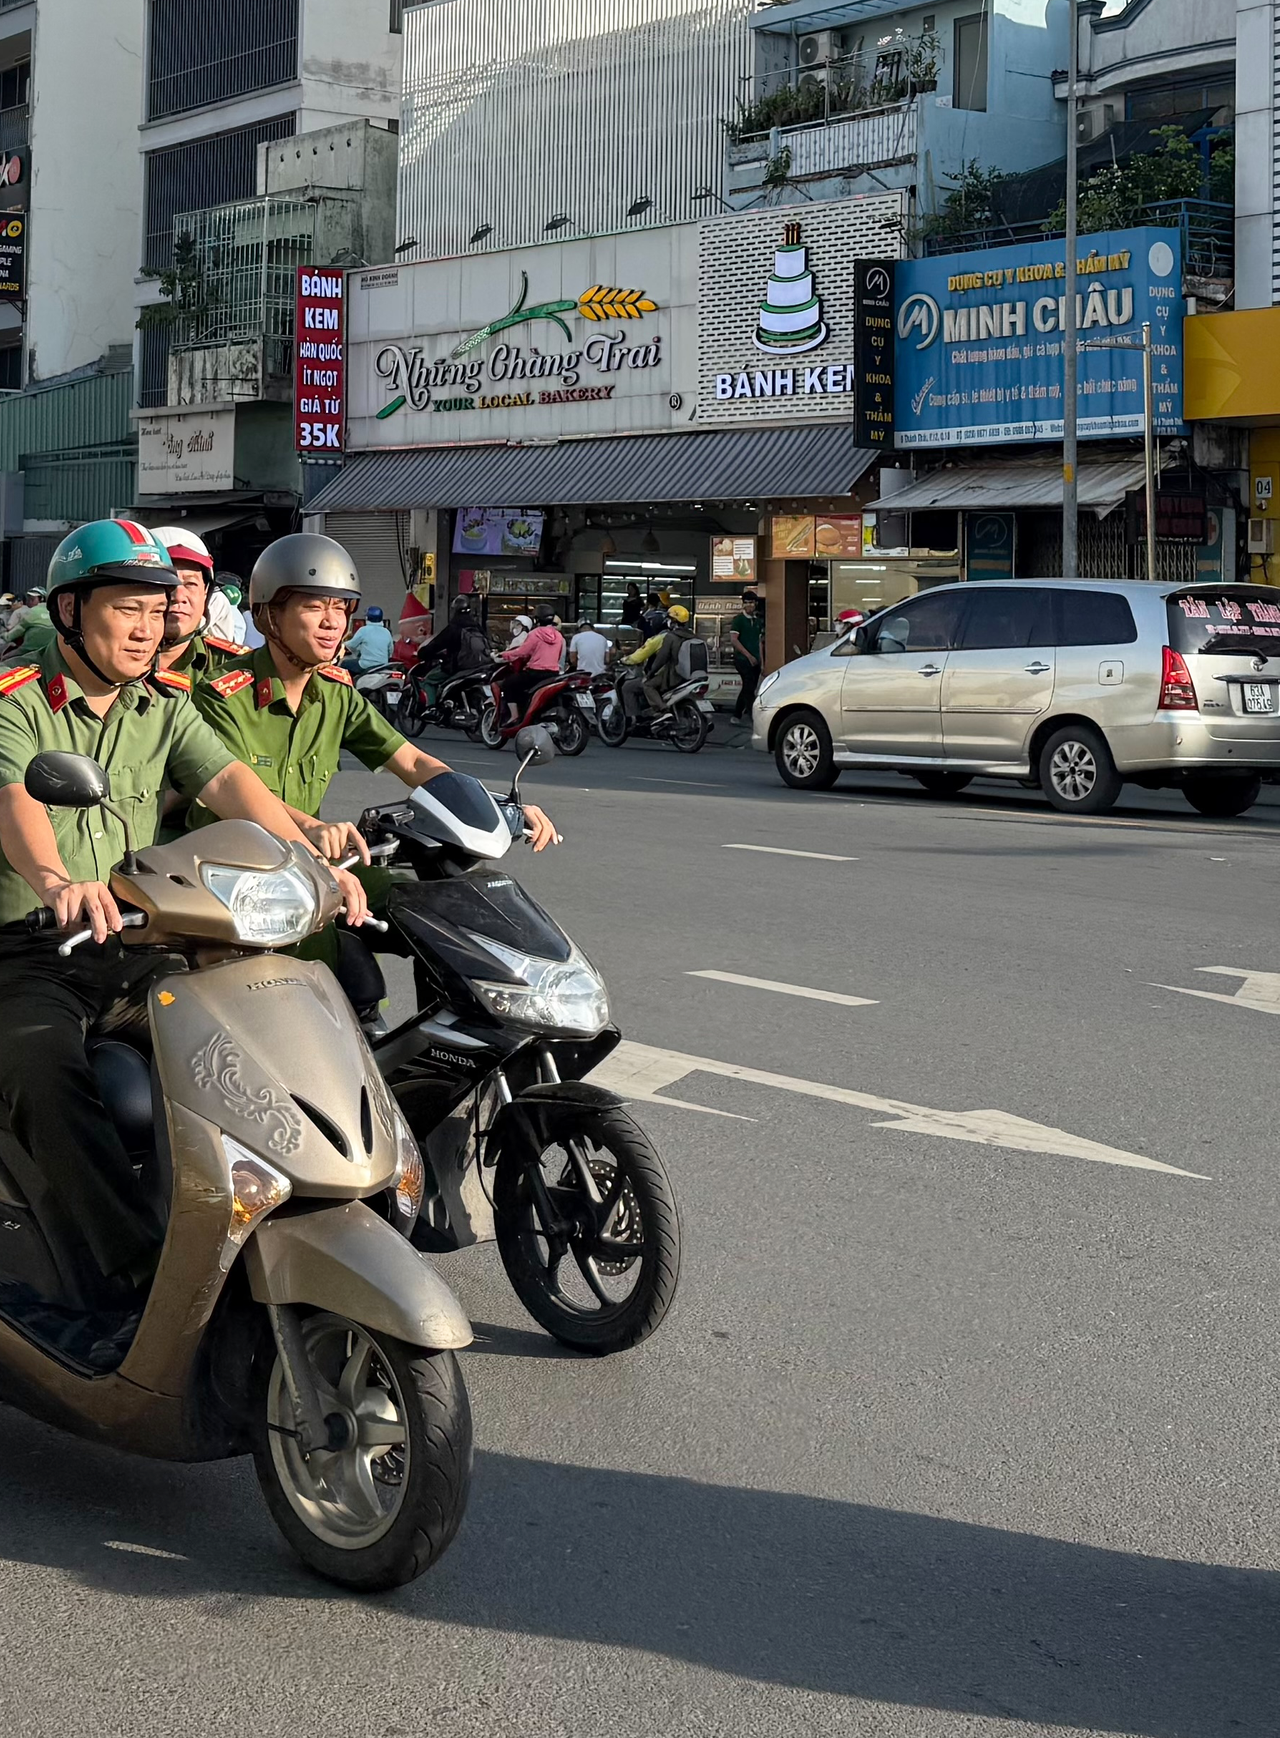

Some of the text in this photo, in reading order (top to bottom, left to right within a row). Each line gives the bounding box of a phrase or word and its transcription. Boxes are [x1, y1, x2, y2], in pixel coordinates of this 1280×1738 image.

[948, 272, 983, 295] DỤNG
[984, 269, 1004, 290] CỤ
[1004, 268, 1014, 284] Y
[1016, 263, 1054, 283] KHOA
[1054, 261, 1065, 279] &
[1076, 249, 1107, 275] HẨM
[301, 270, 342, 298] BÁNH
[1149, 286, 1175, 300] DỤNG
[304, 307, 339, 330] KEM
[943, 281, 1133, 344] MINH CHÂU
[1156, 306, 1169, 320] CỤ
[865, 316, 891, 331] DỤNG
[1160, 325, 1166, 337] Y
[299, 337, 342, 361] HÀN QUỐC
[871, 336, 885, 350] CỤ
[1151, 344, 1177, 356] KHOA
[874, 355, 882, 366] Y
[374, 330, 662, 411] Những Chàng Trai
[1160, 364, 1168, 374] &
[303, 365, 338, 391] ÍT NGỌT
[716, 364, 794, 400] BÁNH
[865, 373, 891, 385] KHOA
[300, 395, 340, 414] GIÁ TỪ
[432, 385, 615, 412] YOUR LOCAL BAKERY
[875, 392, 882, 402] &
[865, 406, 892, 422] THẨM
[299, 422, 341, 448] 35K
[870, 428, 885, 441] MỸ
[1256, 480, 1271, 494] 04
[247, 977, 307, 992] HONDA
[430, 1048, 476, 1068] HONDA
